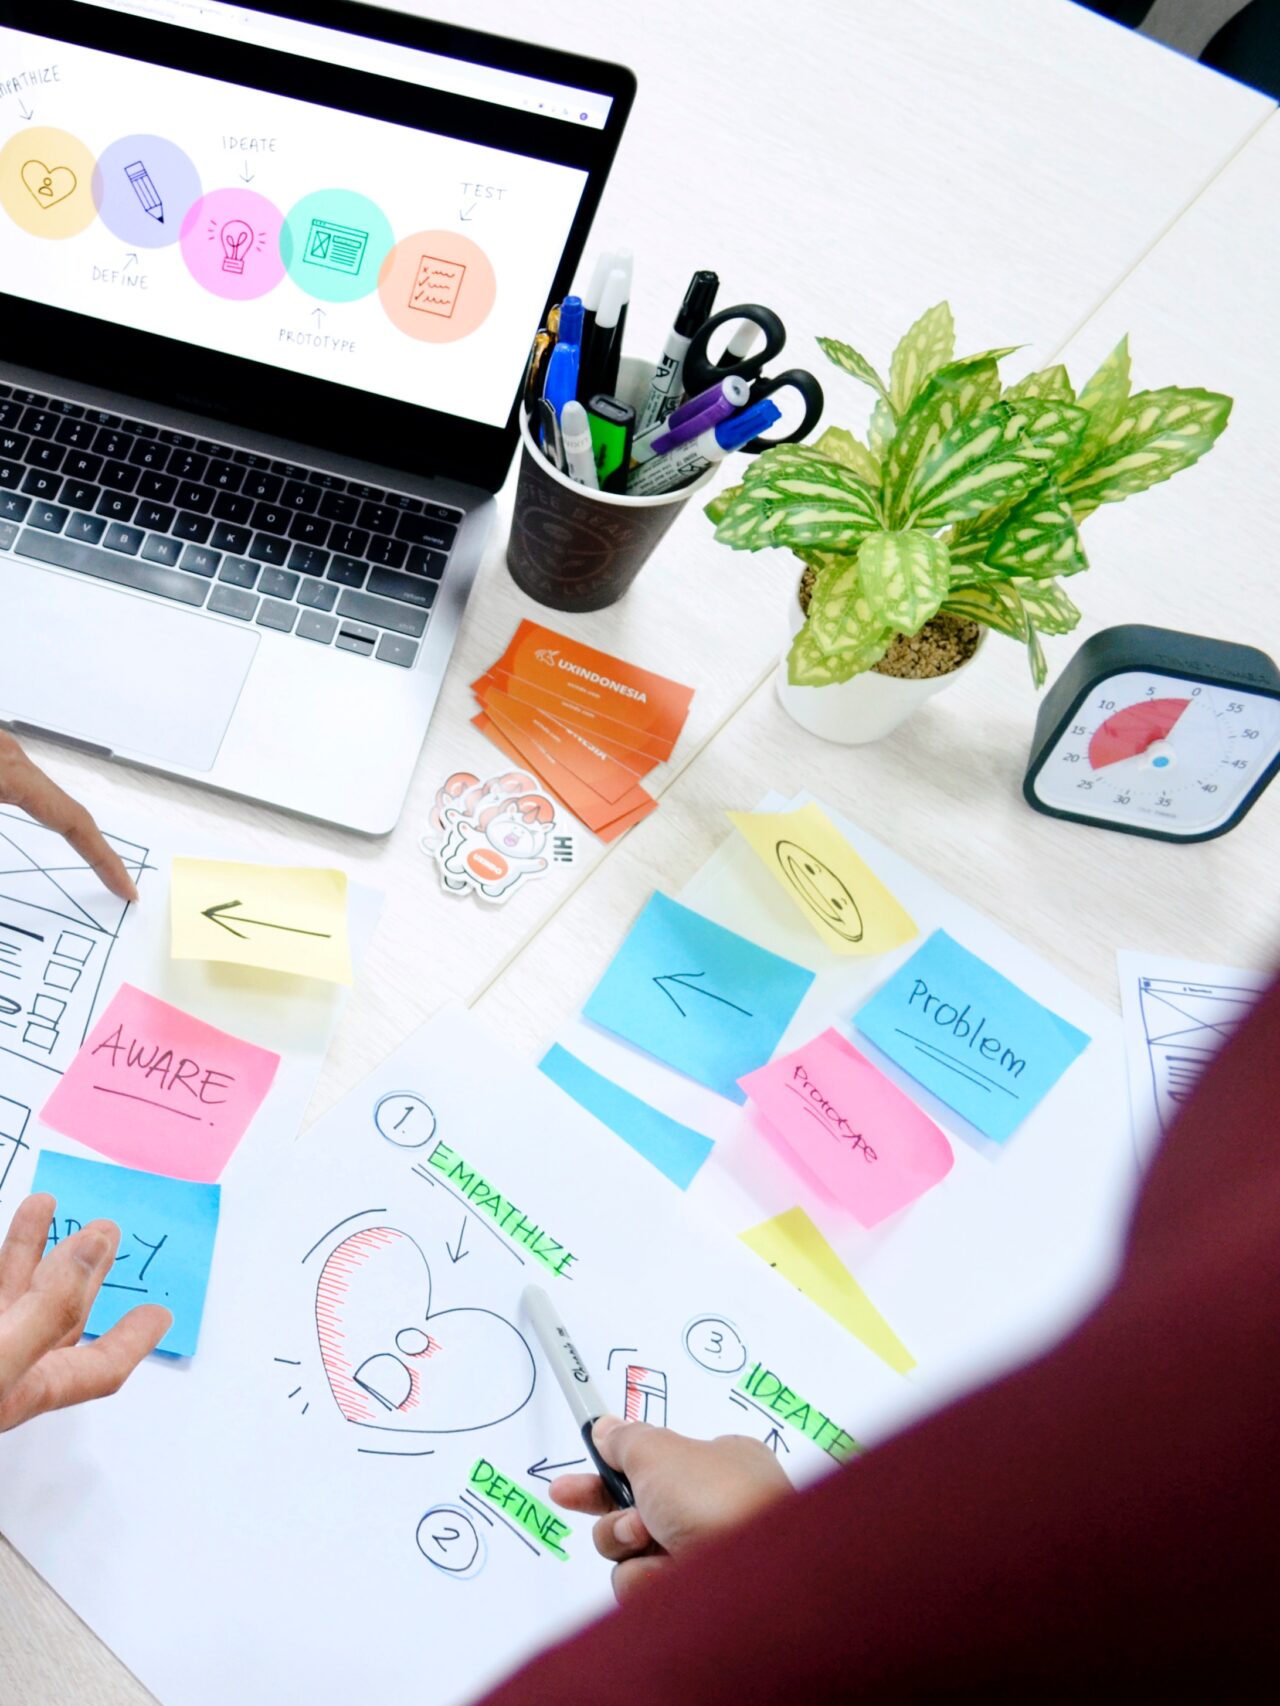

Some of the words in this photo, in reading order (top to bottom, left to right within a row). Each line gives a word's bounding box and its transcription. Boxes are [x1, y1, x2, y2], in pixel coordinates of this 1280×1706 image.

[222, 135, 277, 152] IDEATE
[460, 181, 507, 201] TEST
[92, 265, 148, 290] DEFINE
[279, 328, 357, 353] PROTOTYPE
[558, 659, 647, 703] UXINDONESIA
[1146, 686, 1156, 696] 5
[1191, 687, 1202, 697] 0
[1098, 700, 1115, 710] 10
[1227, 703, 1245, 713] 55
[1070, 726, 1086, 735] 15
[1241, 729, 1260, 740] 50
[1062, 753, 1080, 762] 20
[1231, 760, 1248, 770] 45
[1076, 780, 1094, 790] 25
[1201, 784, 1218, 793] 40
[1113, 795, 1131, 805] 30
[1155, 797, 1171, 807] 35
[908, 979, 1027, 1079] Problem
[92, 1024, 235, 1104] AWARE
[427, 1140, 578, 1281] EMPATHIZE
[745, 1362, 856, 1467] IDEATE
[471, 1459, 567, 1553] DEFINE
